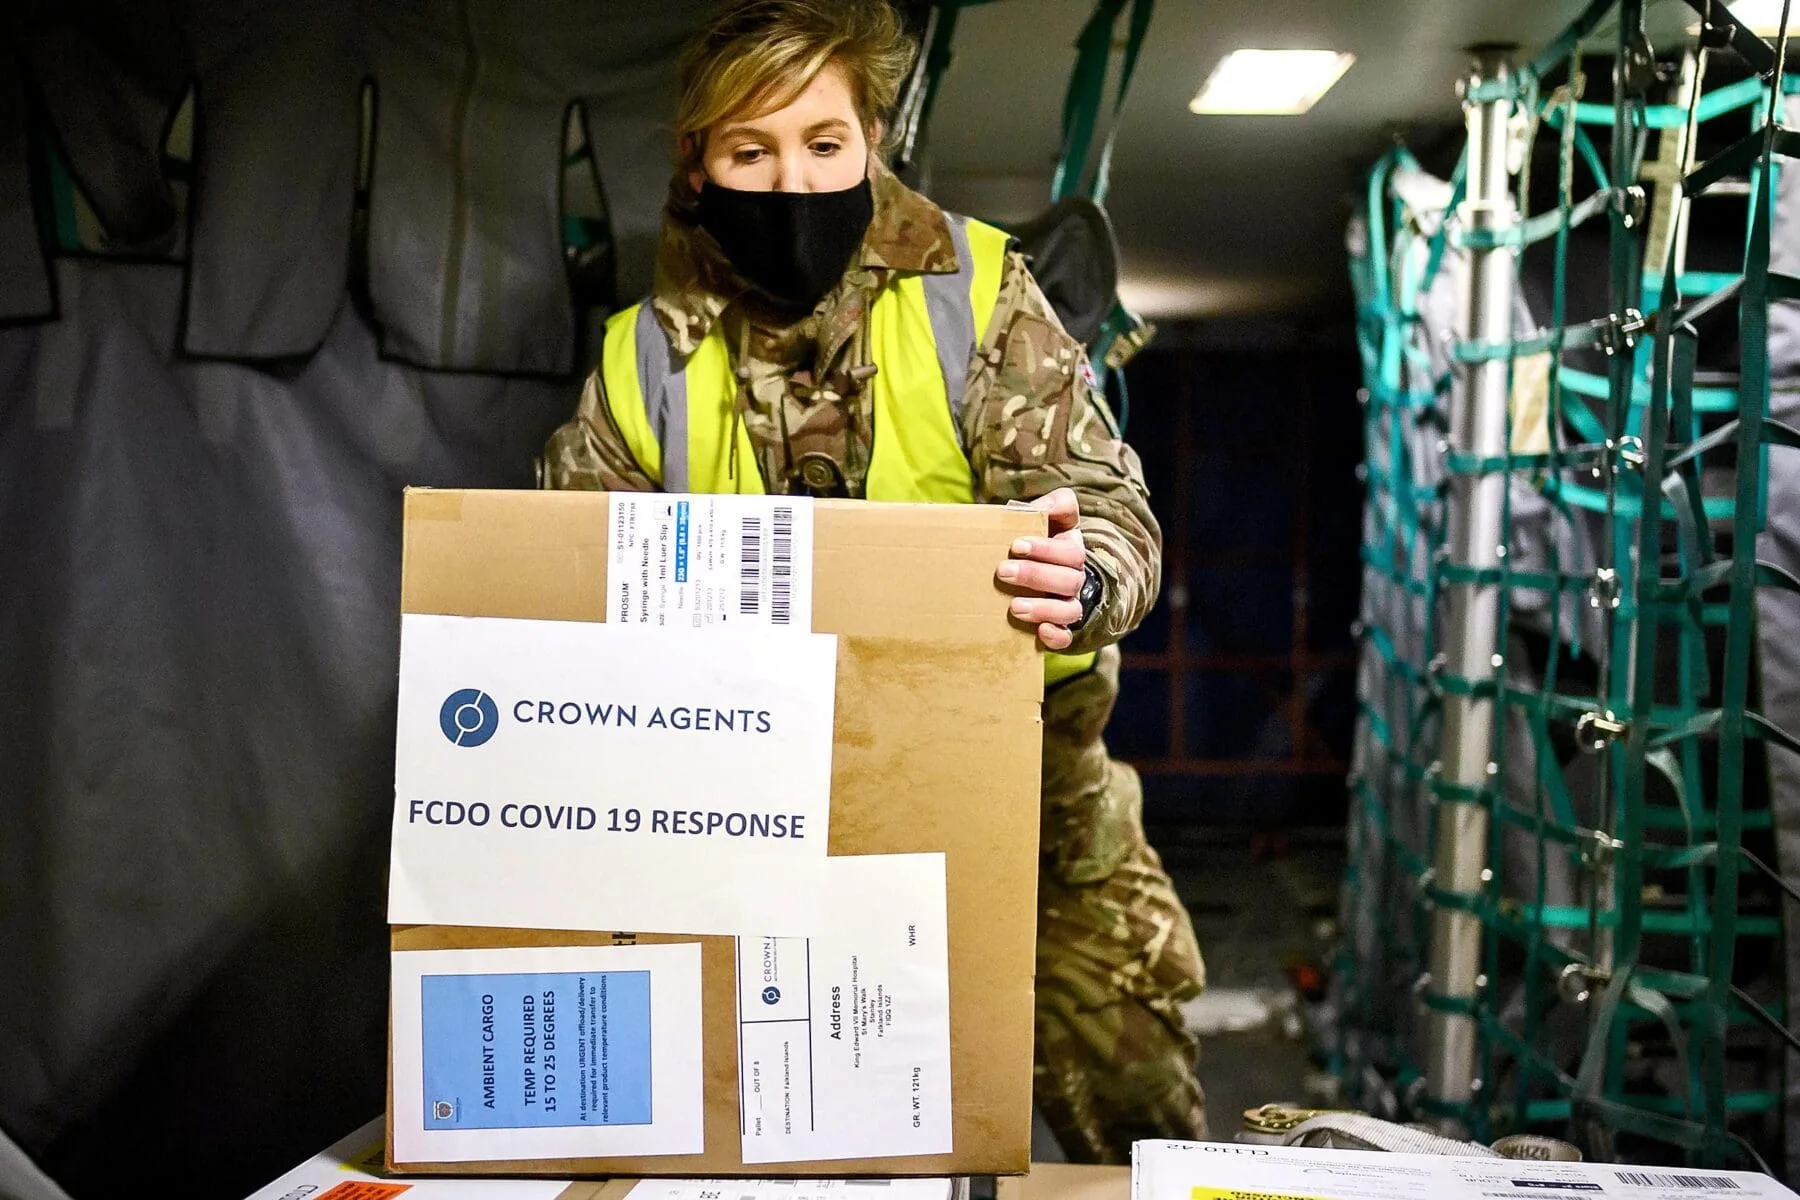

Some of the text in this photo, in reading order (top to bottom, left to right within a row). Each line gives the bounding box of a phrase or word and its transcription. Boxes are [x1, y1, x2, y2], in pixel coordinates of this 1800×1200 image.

[621, 583, 629, 622] PROSUM
[640, 590, 649, 623] Syringe
[514, 700, 771, 733] CROWN AGENTS
[409, 800, 805, 839] FCDO COVID 19 RESPONSE
[908, 925, 916, 946] WHR
[764, 943, 772, 982] CROWN
[578, 978, 587, 1036] offload/delivery
[590, 987, 596, 996] to
[600, 975, 608, 1012] conditions
[830, 986, 841, 1040] Address
[482, 994, 495, 1108] AMBIENT CARGO
[524, 995, 536, 1106] TEMP REQUIRED
[543, 991, 556, 1112] 15 TO 25 DEGREES
[601, 1014, 609, 1060] temperature
[579, 1070, 587, 1110] destination
[601, 1062, 610, 1091] product
[754, 1068, 760, 1076] OF
[911, 1067, 921, 1092] 121kg
[590, 1081, 598, 1111] required
[579, 1113, 586, 1121] At
[913, 1113, 921, 1128] GR.
